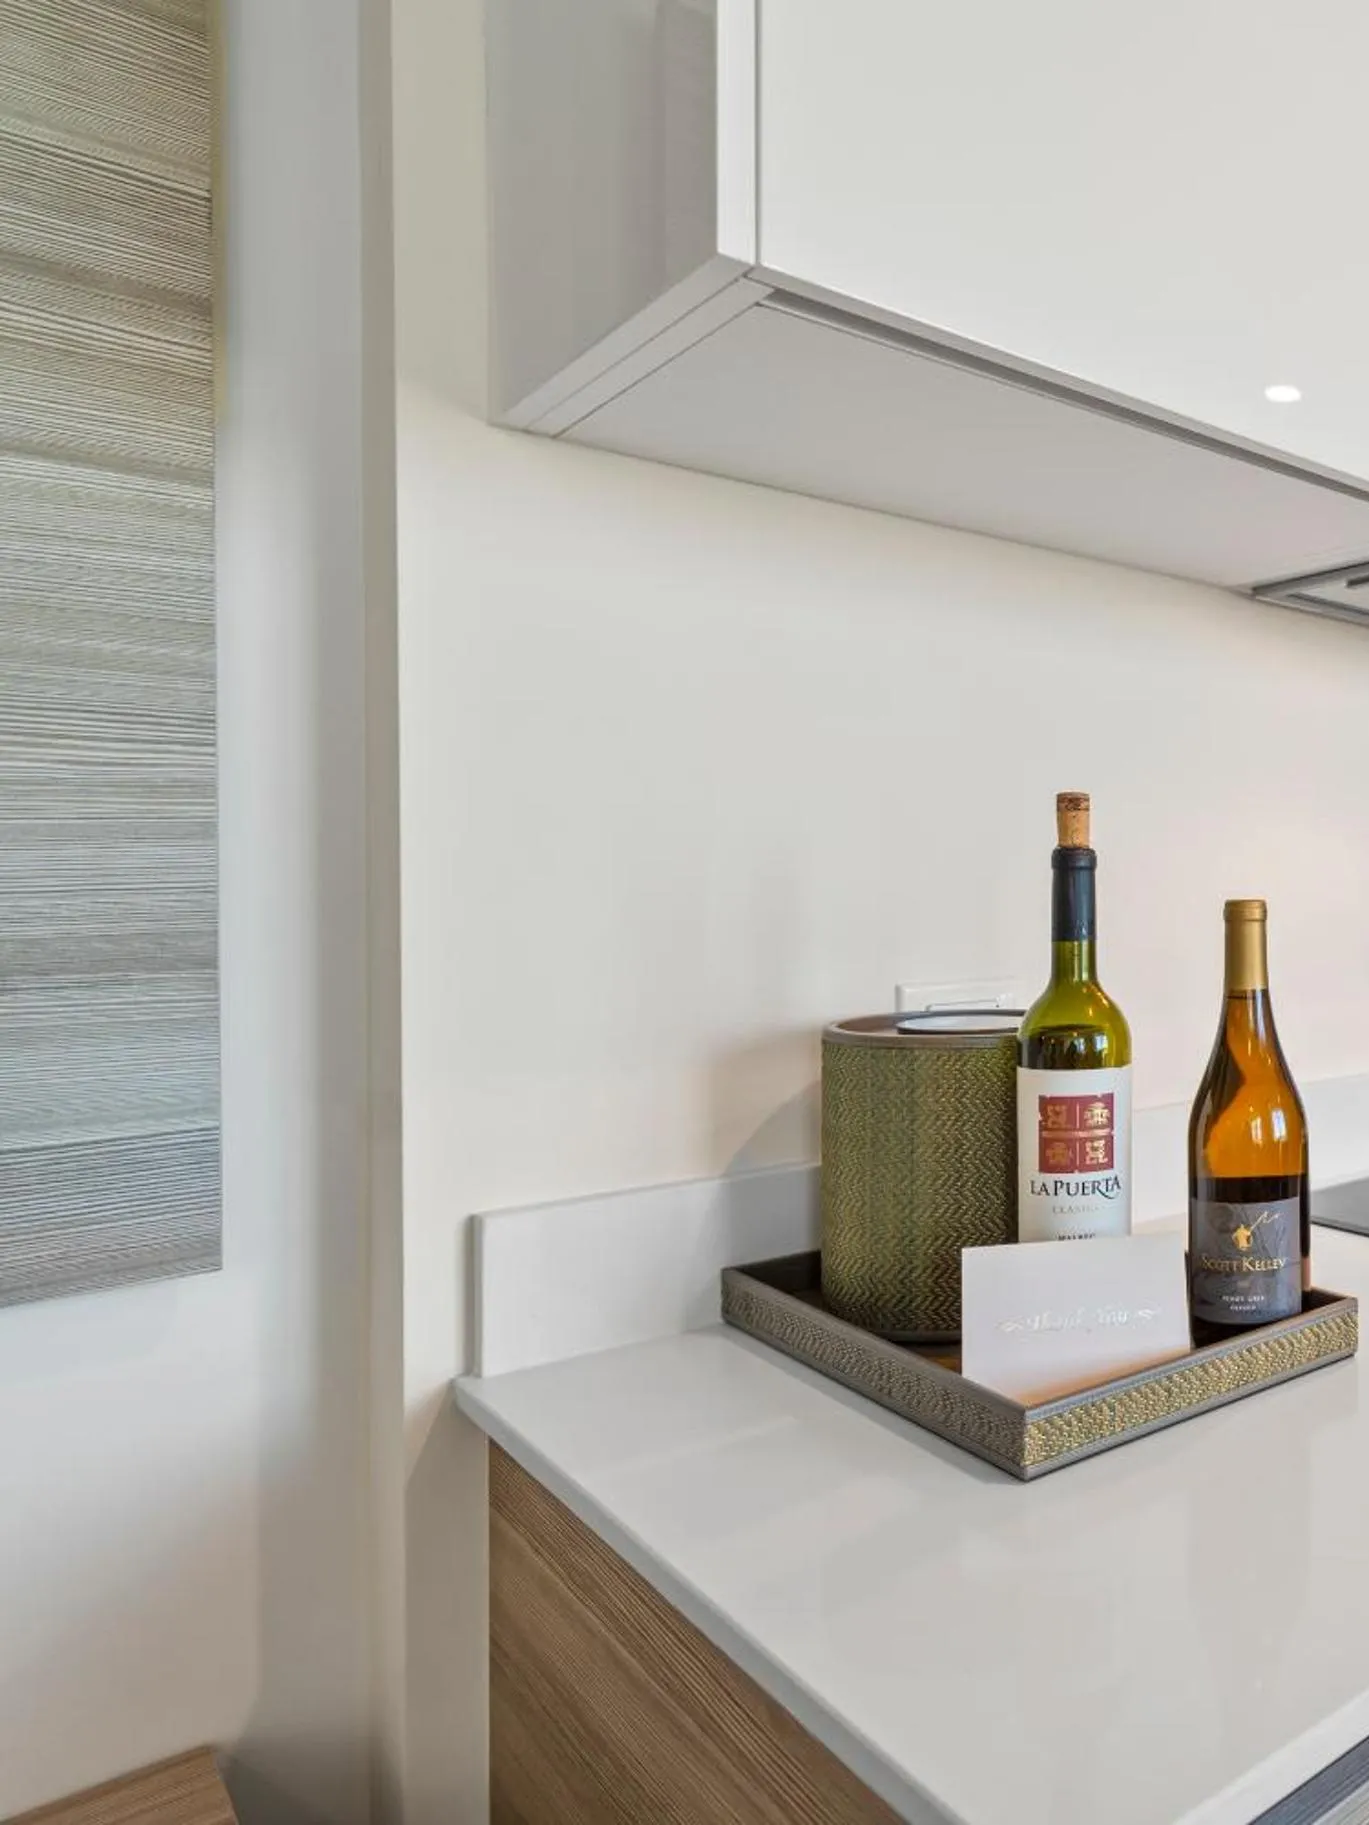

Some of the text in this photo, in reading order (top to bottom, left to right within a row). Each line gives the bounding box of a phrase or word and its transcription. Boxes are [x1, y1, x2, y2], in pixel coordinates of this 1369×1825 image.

[1029, 1174, 1122, 1200] LA PUERTA
[1241, 1256, 1288, 1273] KELLEY
